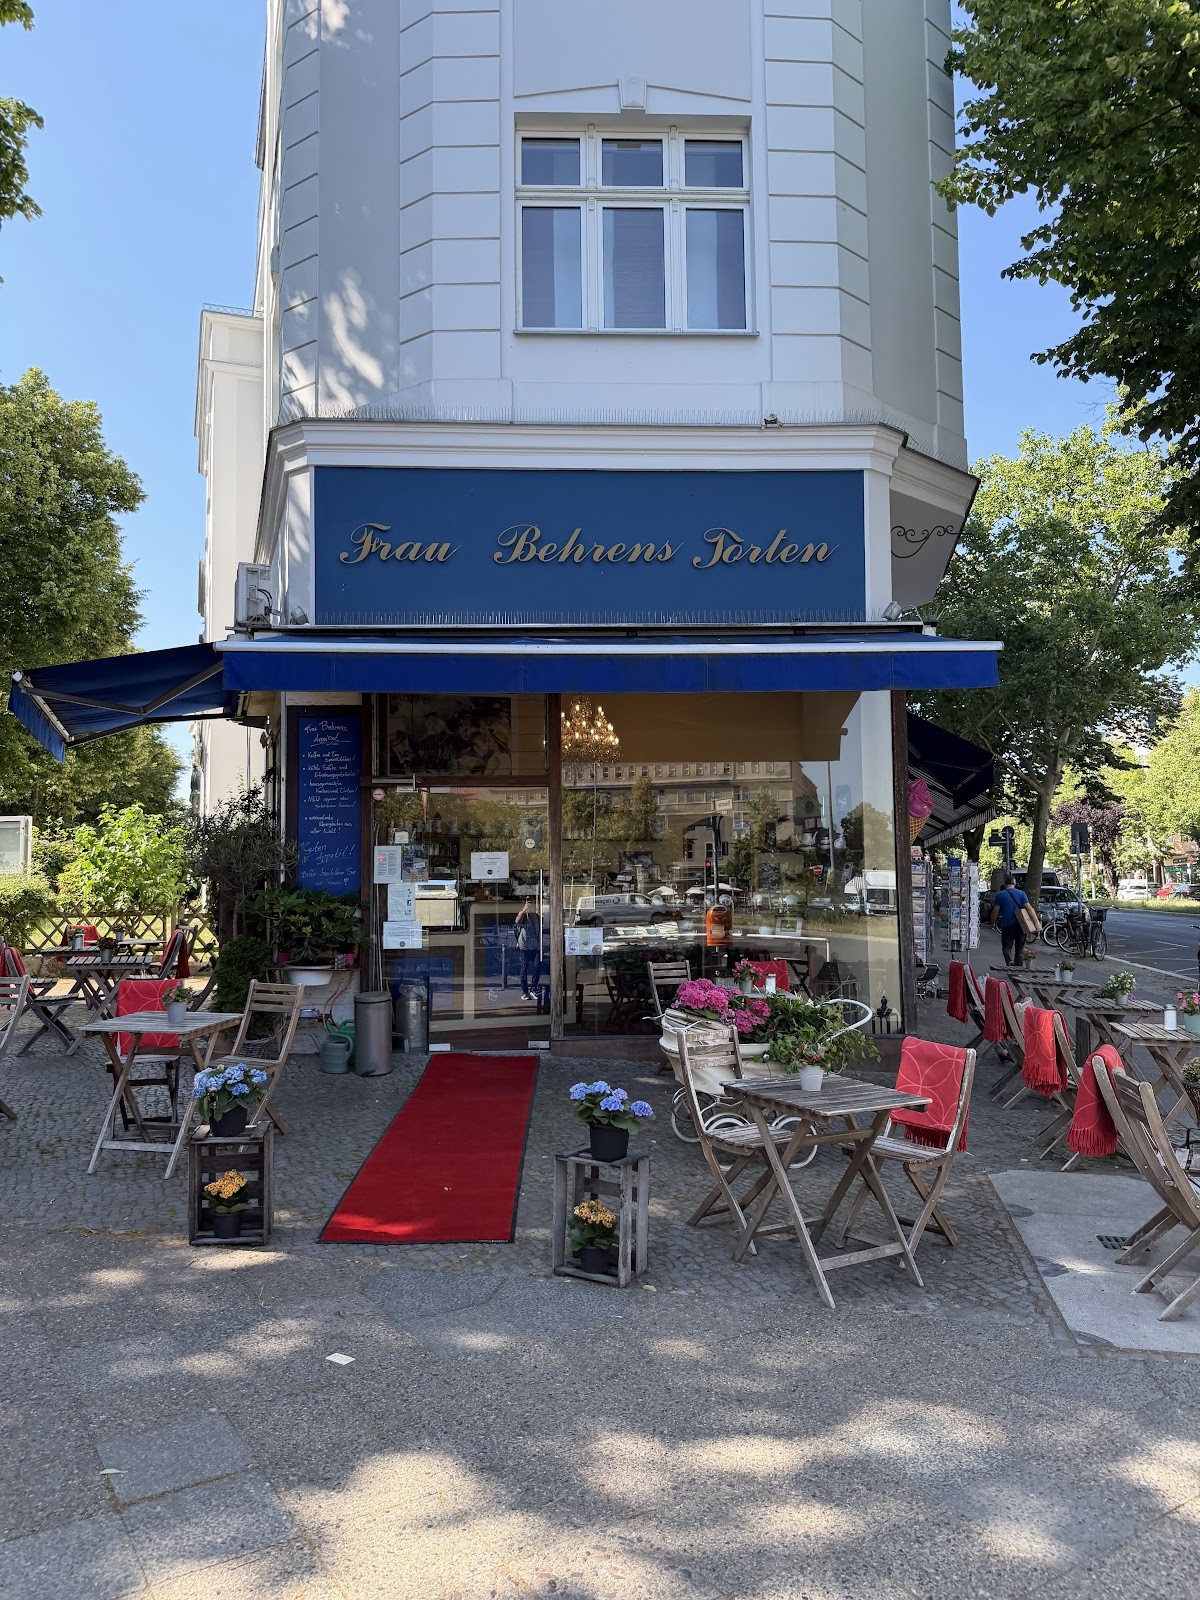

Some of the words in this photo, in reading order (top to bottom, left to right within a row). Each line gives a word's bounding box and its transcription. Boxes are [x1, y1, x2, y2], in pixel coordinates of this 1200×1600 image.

[339, 521, 461, 565] Frau
[493, 523, 683, 566] Behrens
[692, 526, 839, 570] Torten
[304, 723, 318, 734] Frau
[320, 720, 348, 732] Behrens
[304, 841, 328, 856] Guten
